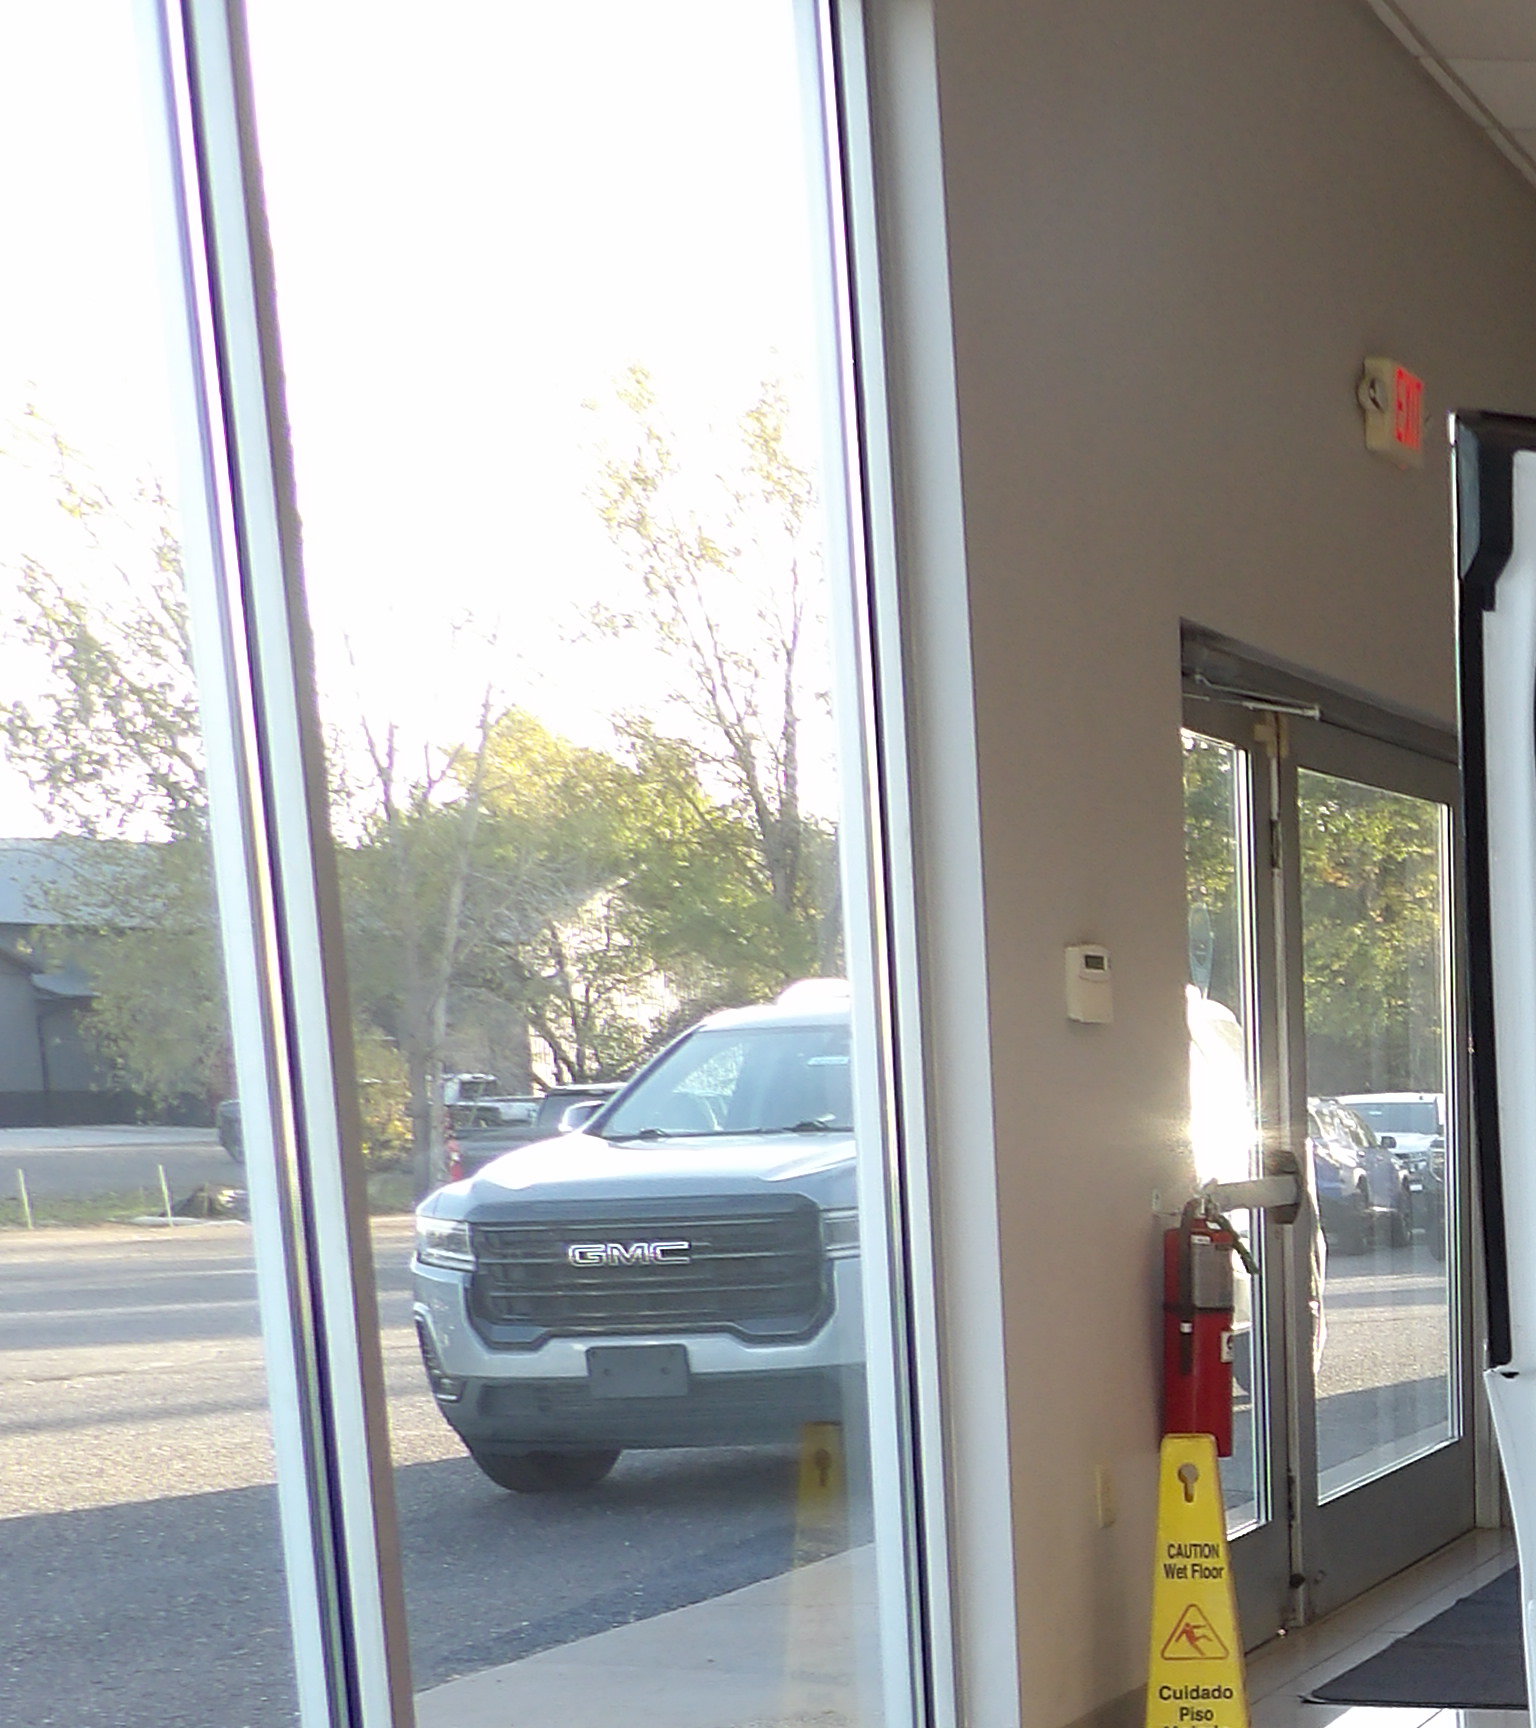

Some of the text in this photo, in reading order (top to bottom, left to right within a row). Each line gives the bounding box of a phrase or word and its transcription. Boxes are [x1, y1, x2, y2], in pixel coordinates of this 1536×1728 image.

[567, 1240, 691, 1267] GMC
[1167, 1543, 1220, 1559] CAUTION
[1163, 1563, 1225, 1579] Wet Floor
[1159, 1684, 1234, 1701] Cuidado
[1179, 1706, 1214, 1722] Piso
